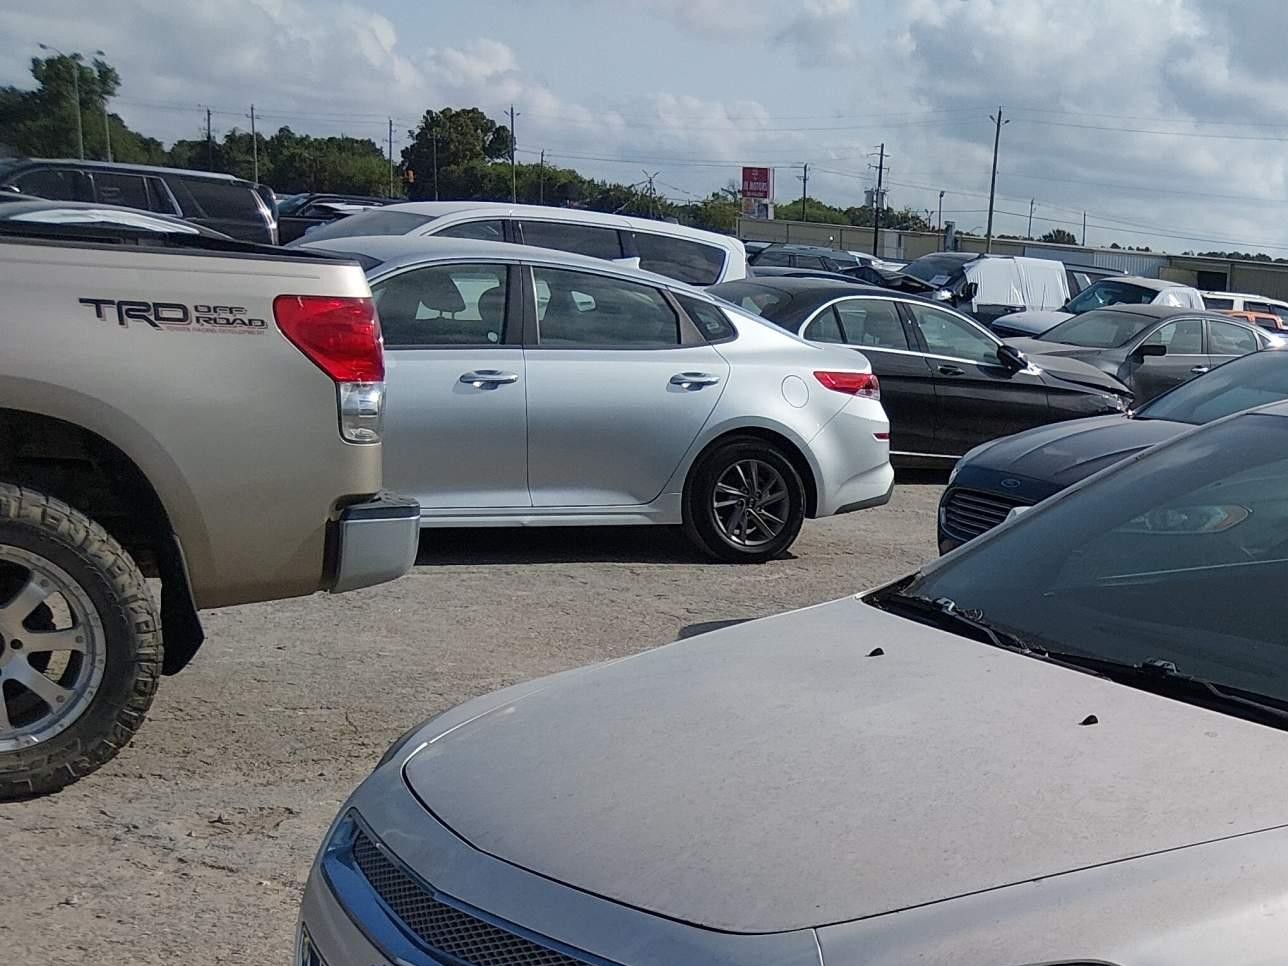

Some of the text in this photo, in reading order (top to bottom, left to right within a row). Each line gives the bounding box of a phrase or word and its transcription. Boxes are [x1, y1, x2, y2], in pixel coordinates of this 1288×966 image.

[78, 297, 192, 331] TRD
[194, 303, 247, 317] OFF
[195, 316, 268, 330] ROAD
